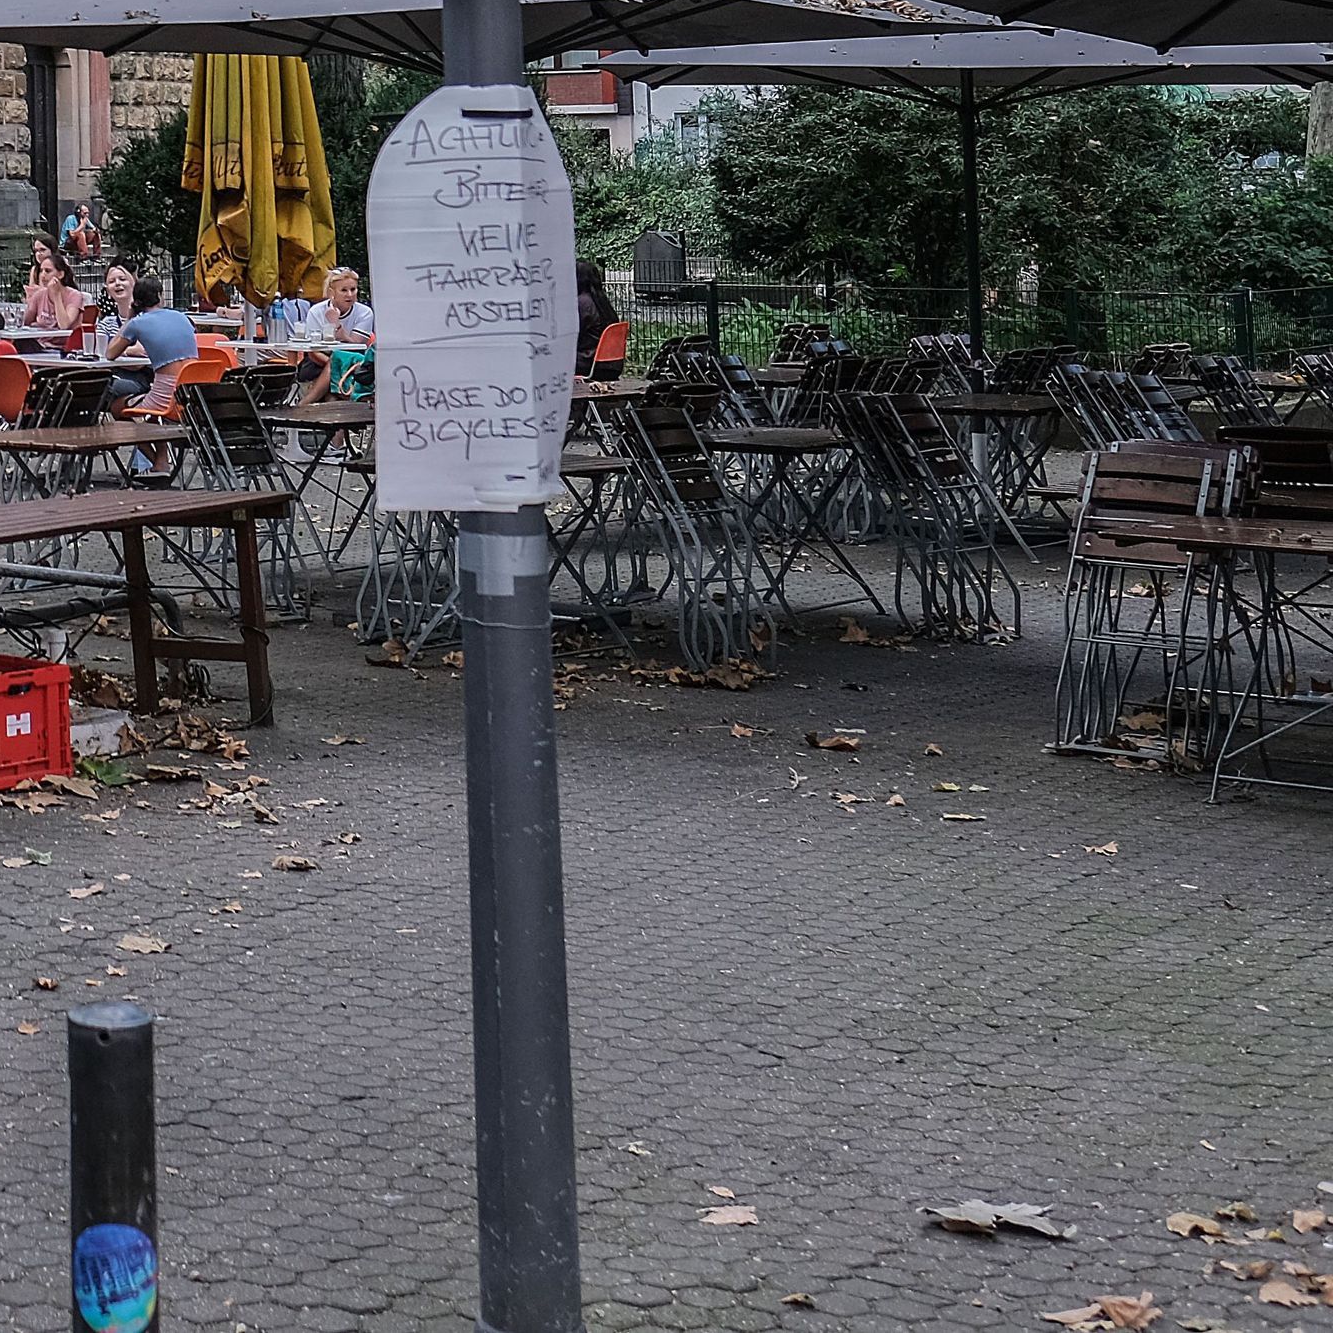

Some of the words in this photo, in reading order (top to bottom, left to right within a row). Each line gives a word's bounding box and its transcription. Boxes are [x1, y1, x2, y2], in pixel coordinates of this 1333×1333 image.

[392, 364, 485, 414] PLEASE
[488, 384, 529, 408] DO
[396, 416, 540, 461] BICYCLES
